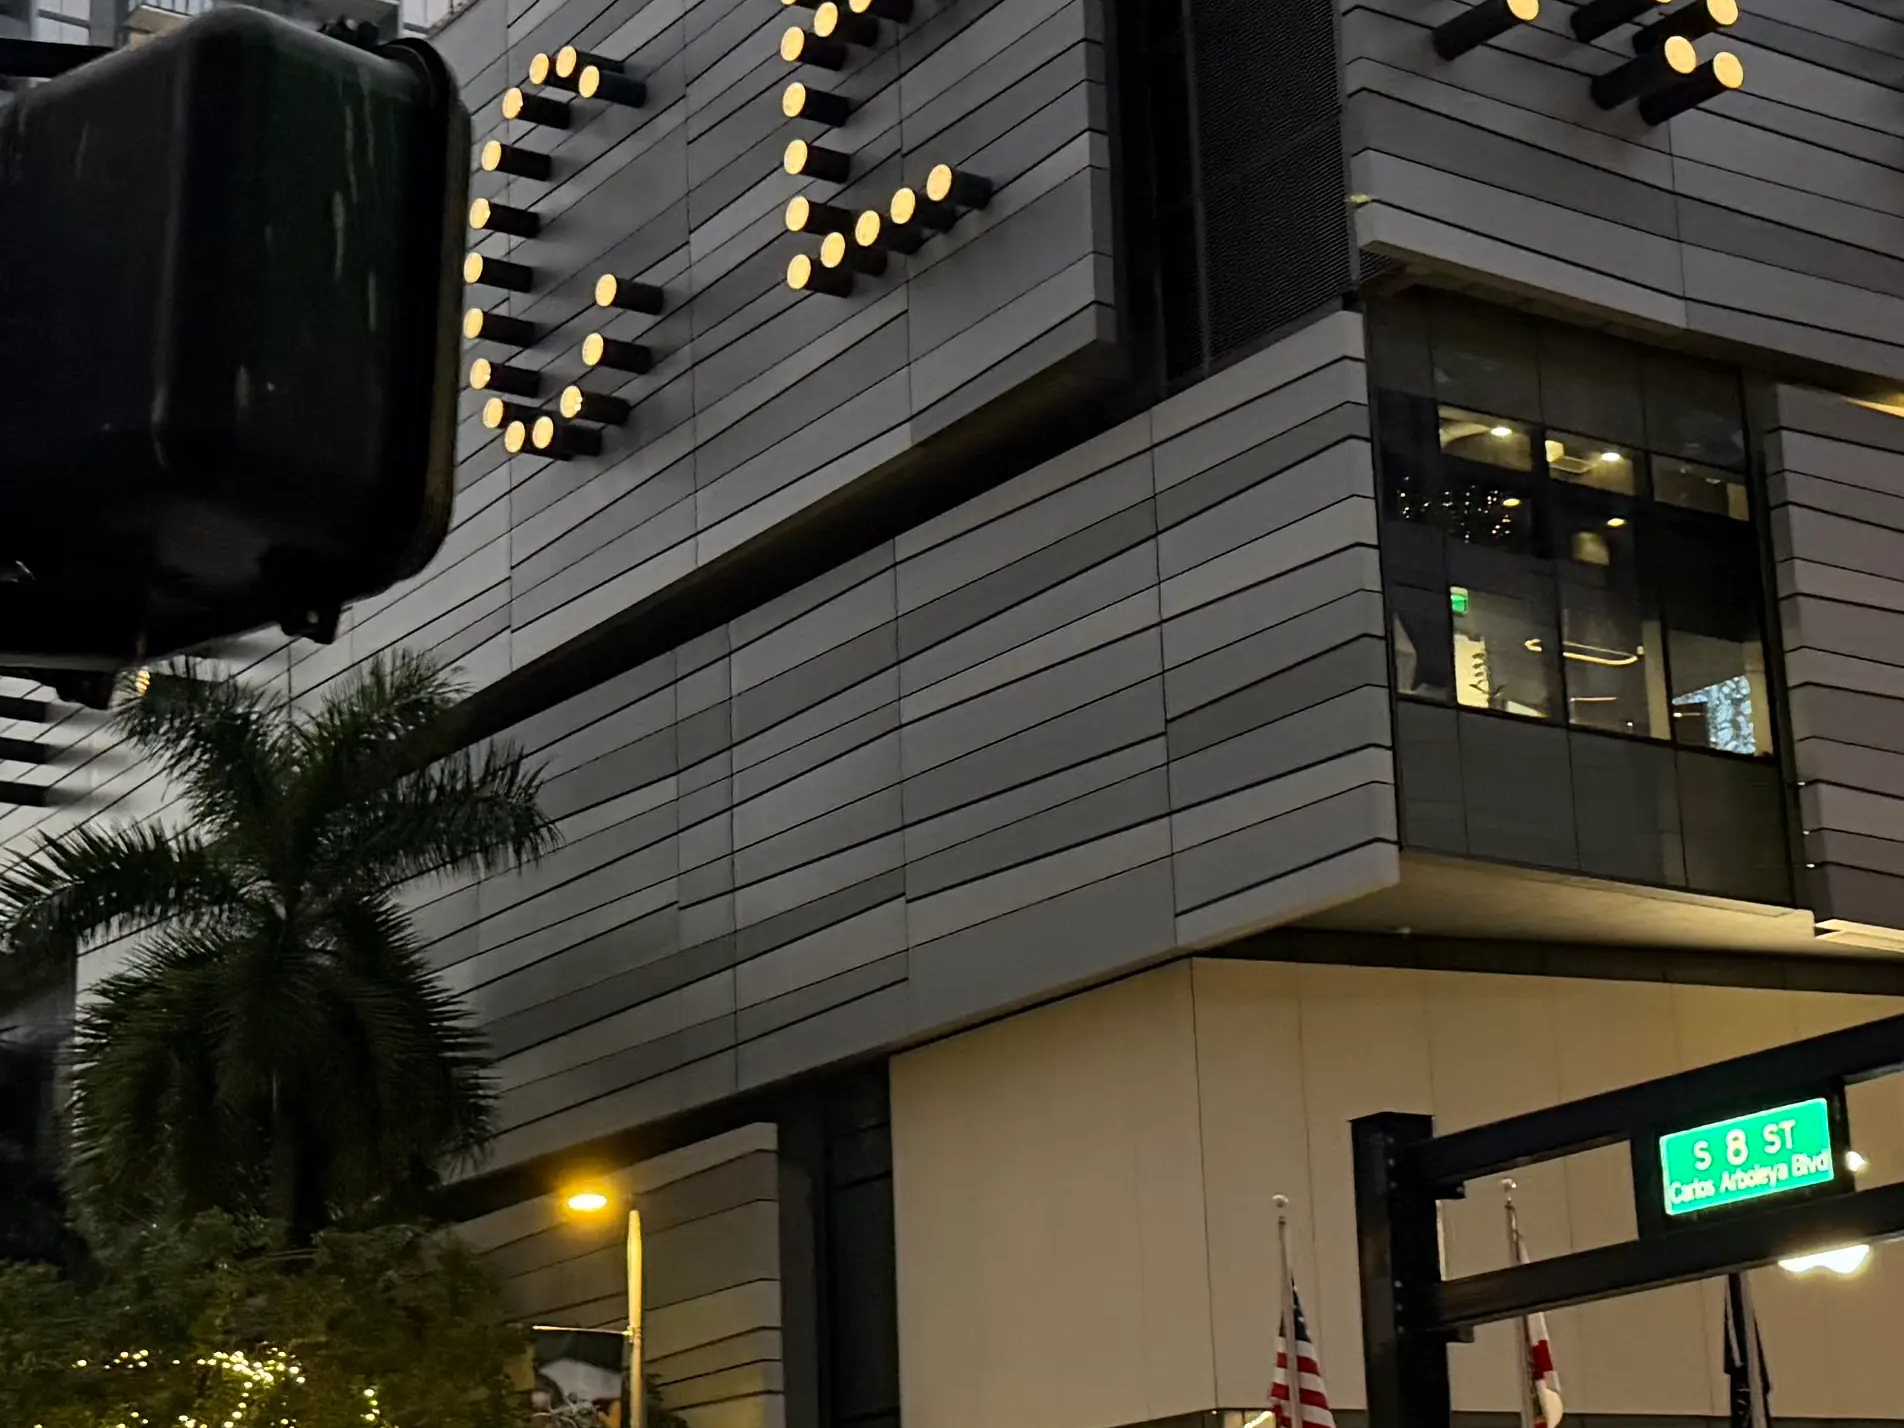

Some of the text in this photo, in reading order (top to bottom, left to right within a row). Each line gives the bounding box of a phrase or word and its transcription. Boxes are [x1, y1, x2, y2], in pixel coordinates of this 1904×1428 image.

[1693, 1119, 1796, 1170] S 8 ST
[1671, 1149, 1831, 1204] Carlos Arboleya Blvd
